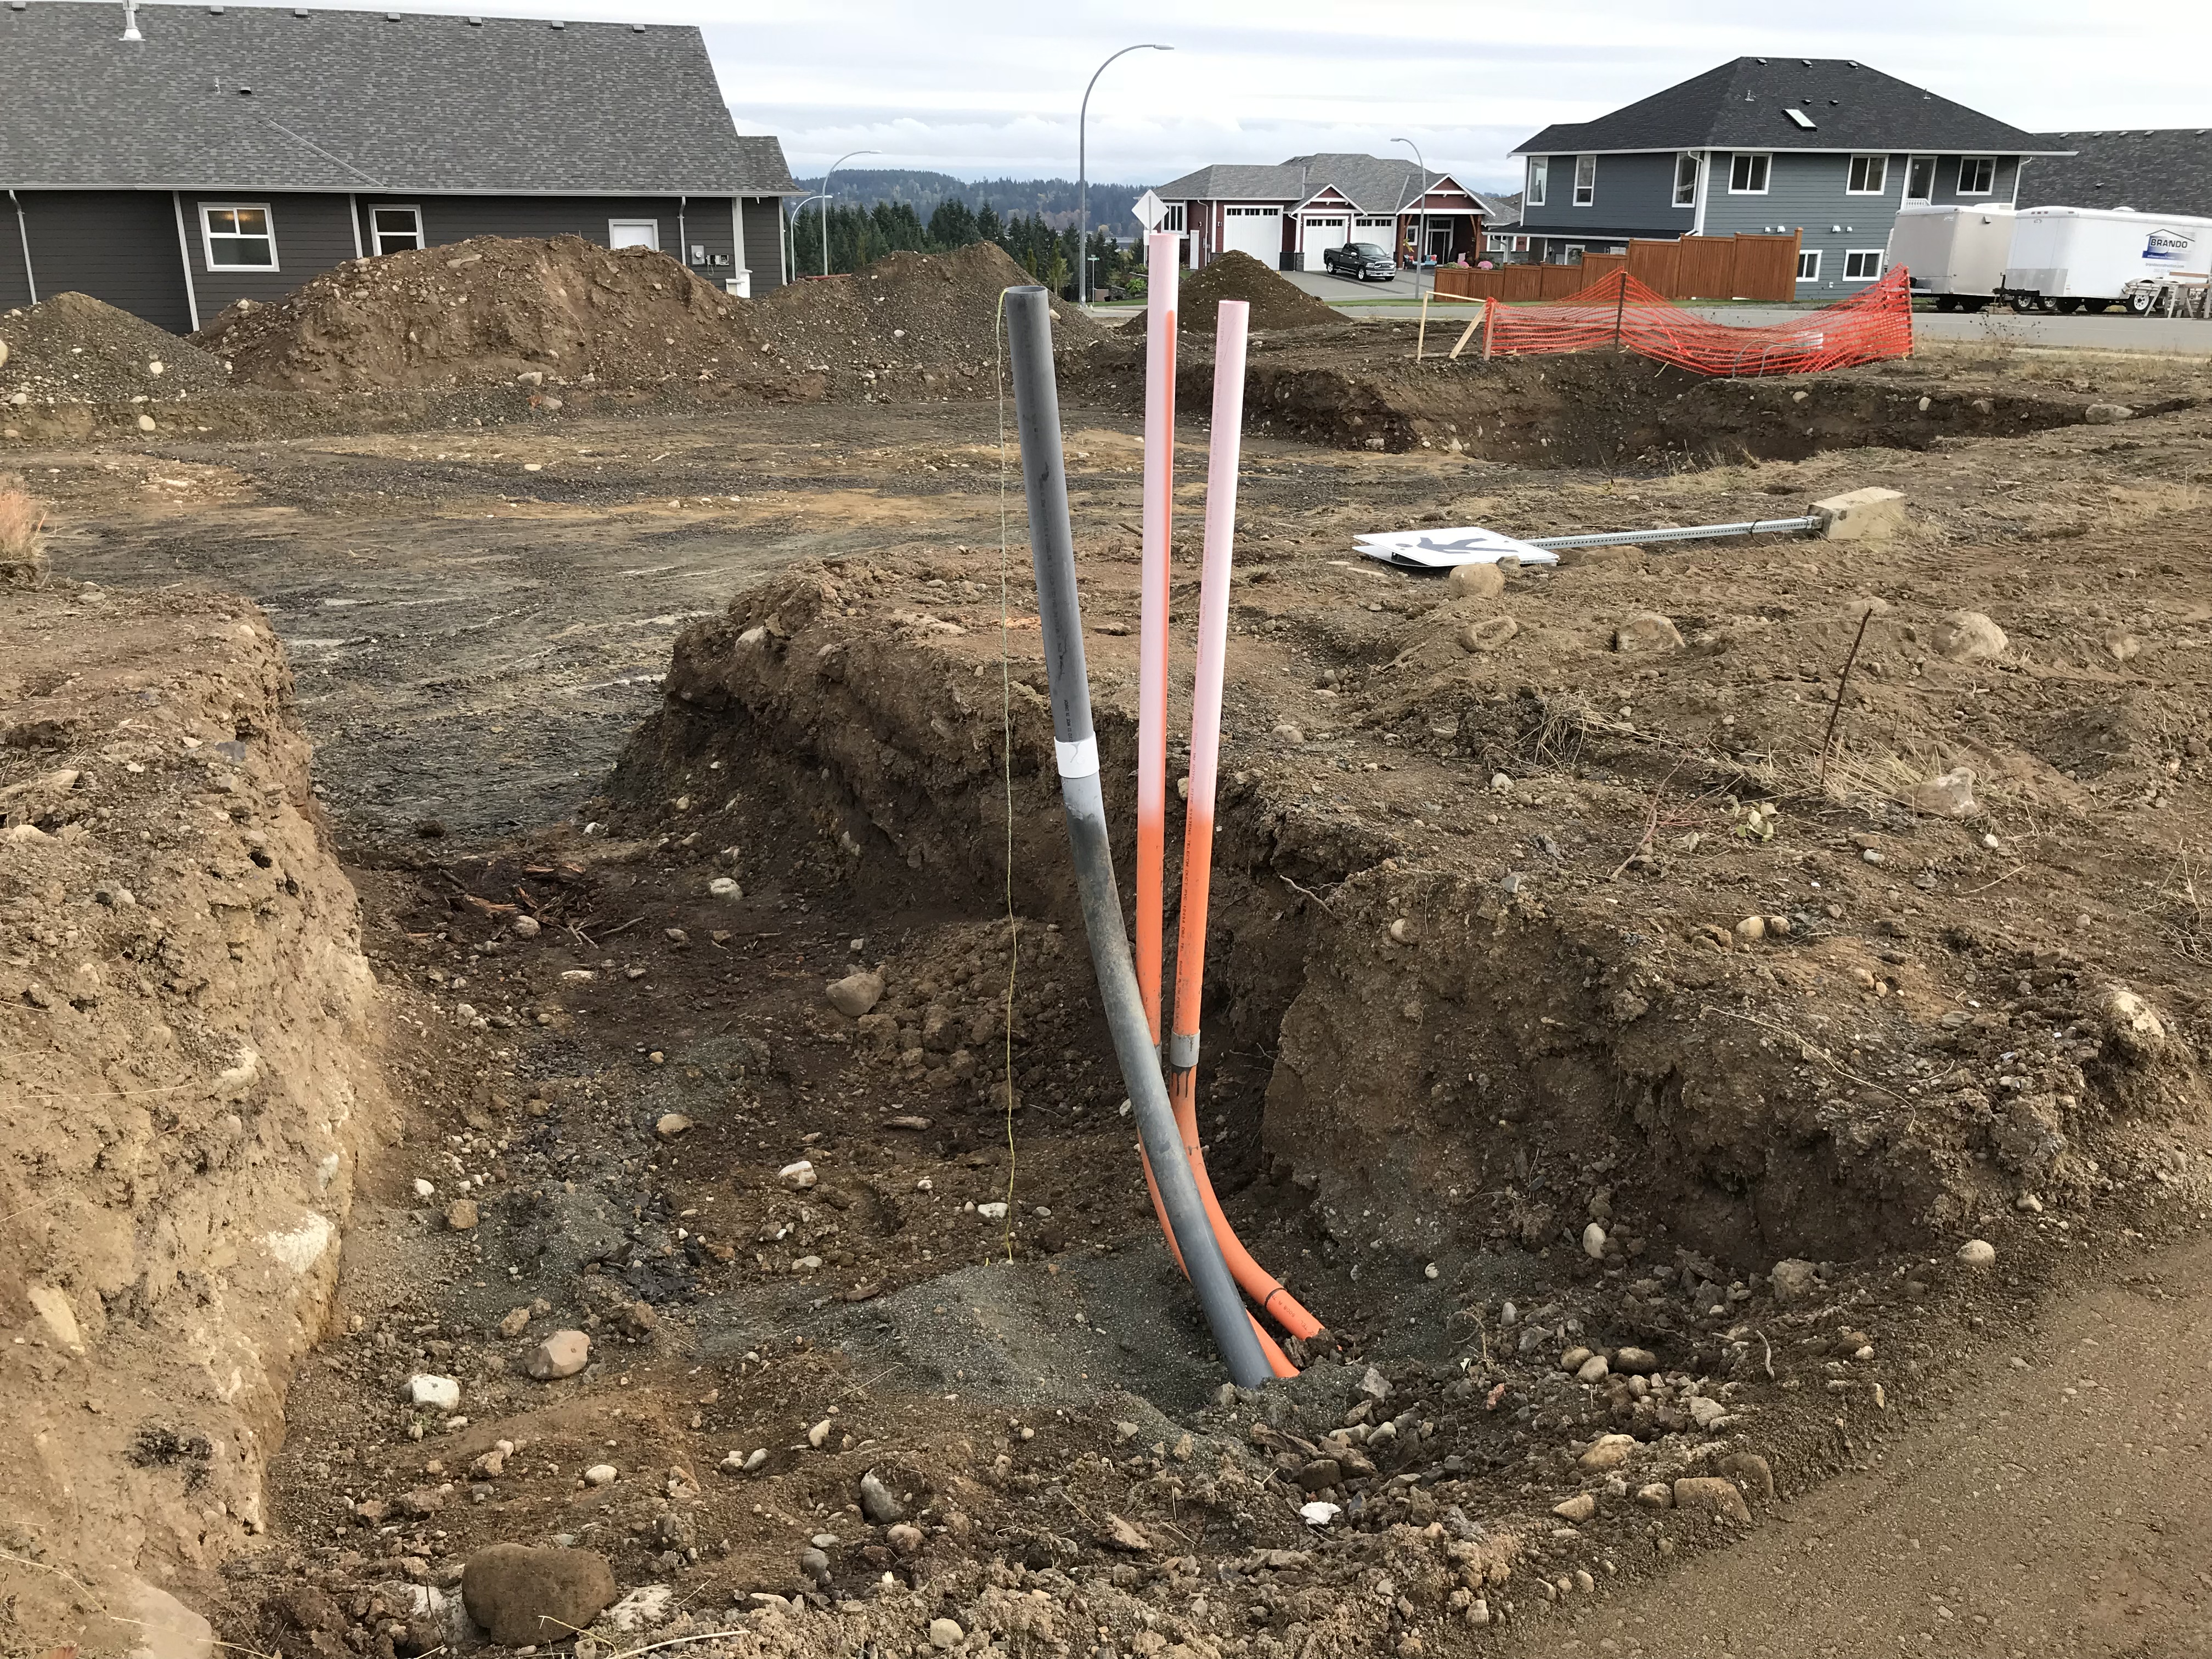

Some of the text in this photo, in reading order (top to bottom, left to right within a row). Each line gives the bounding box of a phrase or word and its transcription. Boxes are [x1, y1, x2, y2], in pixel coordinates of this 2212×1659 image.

[2151, 239, 2188, 248] BRANDO
[1201, 627, 1205, 635] IN
[1300, 1320, 1309, 1330] TEL
